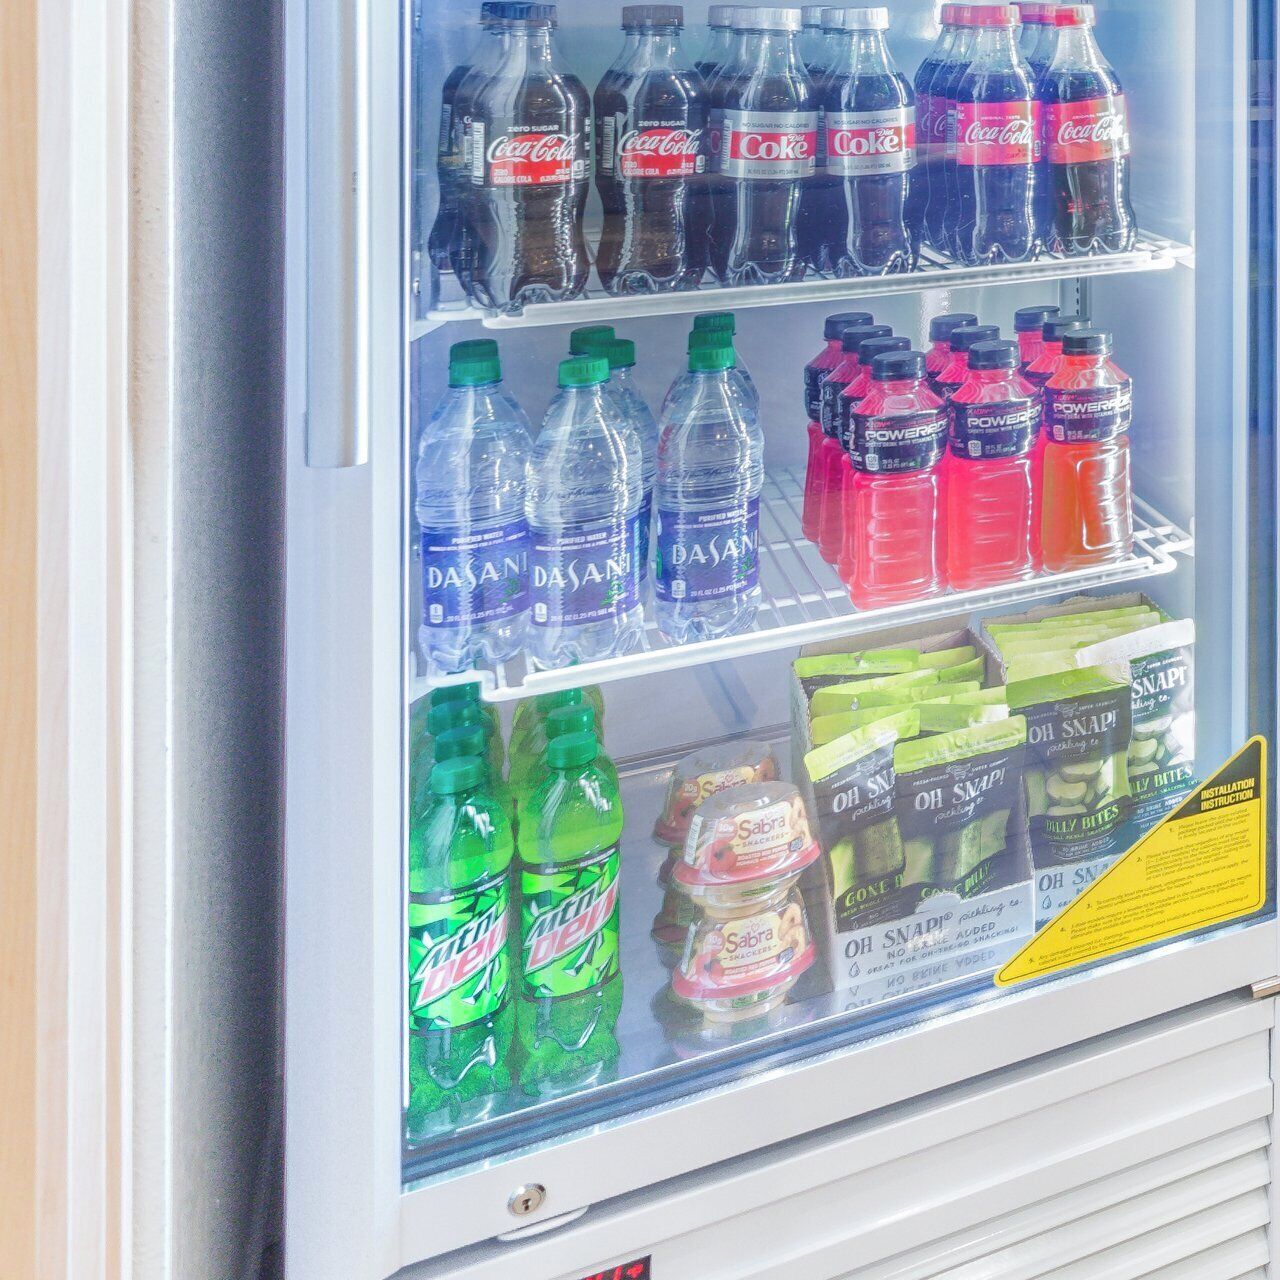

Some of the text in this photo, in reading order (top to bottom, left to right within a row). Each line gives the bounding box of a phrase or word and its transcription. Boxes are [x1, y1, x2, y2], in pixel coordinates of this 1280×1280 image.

[531, 124, 559, 132] SUGAR
[964, 120, 1034, 145] Coca-Cola
[487, 132, 580, 163] Coca-Cola
[617, 128, 703, 156] Coca-Cola
[739, 134, 809, 160] Coke
[834, 130, 900, 155] Coke
[483, 531, 504, 541] WATER
[588, 531, 607, 541] WATER
[672, 529, 759, 570] DASANI
[427, 551, 528, 592] DASANI
[534, 552, 631, 593] DASANI
[1028, 709, 1117, 744] OH SNAP!
[914, 767, 1006, 810] OH SNAP!
[1154, 765, 1193, 788] BITES
[1200, 777, 1255, 800] INSTALLATION
[832, 786, 860, 813] OH
[1200, 789, 1253, 811] INSTRUCTION
[738, 815, 786, 840] Sabra
[1082, 804, 1120, 829] BITES
[742, 833, 786, 848] SNACKERS
[844, 878, 890, 907] GONE
[1038, 871, 1065, 892] OH
[959, 900, 1006, 925] pickling
[725, 928, 774, 954] Sabra
[844, 935, 873, 960] OH
[887, 921, 996, 960] NO ADDED
[729, 946, 772, 962] SNACKERS
[867, 955, 919, 976] GREAT FOR
